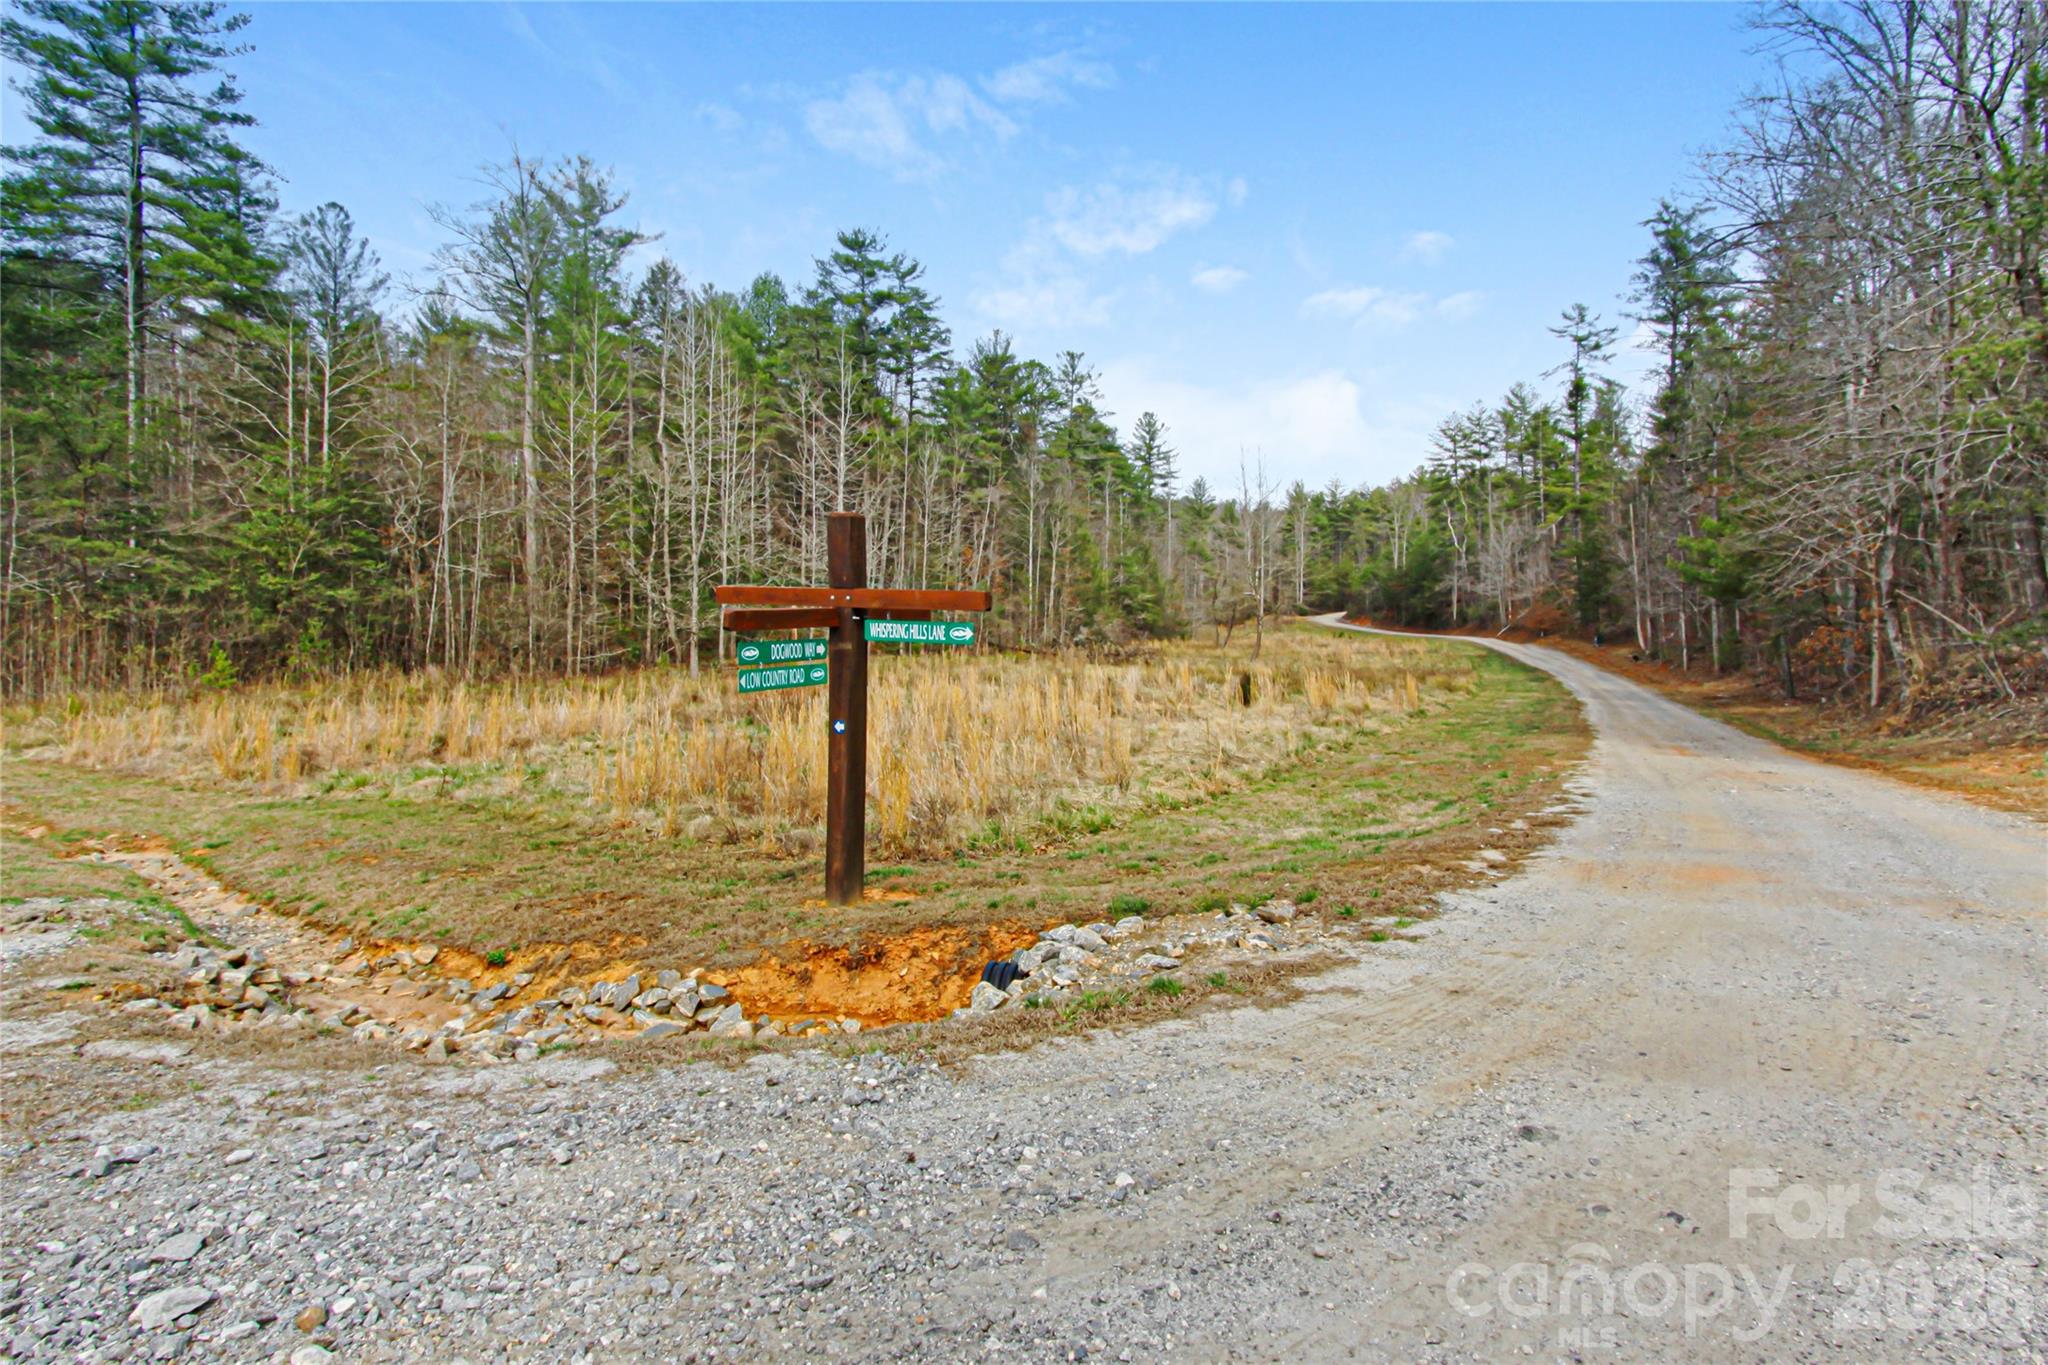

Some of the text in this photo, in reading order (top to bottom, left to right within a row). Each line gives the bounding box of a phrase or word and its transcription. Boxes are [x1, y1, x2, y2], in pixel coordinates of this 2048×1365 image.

[869, 623, 946, 641] WHISPERING HILLS LANE
[771, 642, 816, 660] DOGWOOD WAY
[746, 668, 805, 689] LOW COUNTRY ROAD
